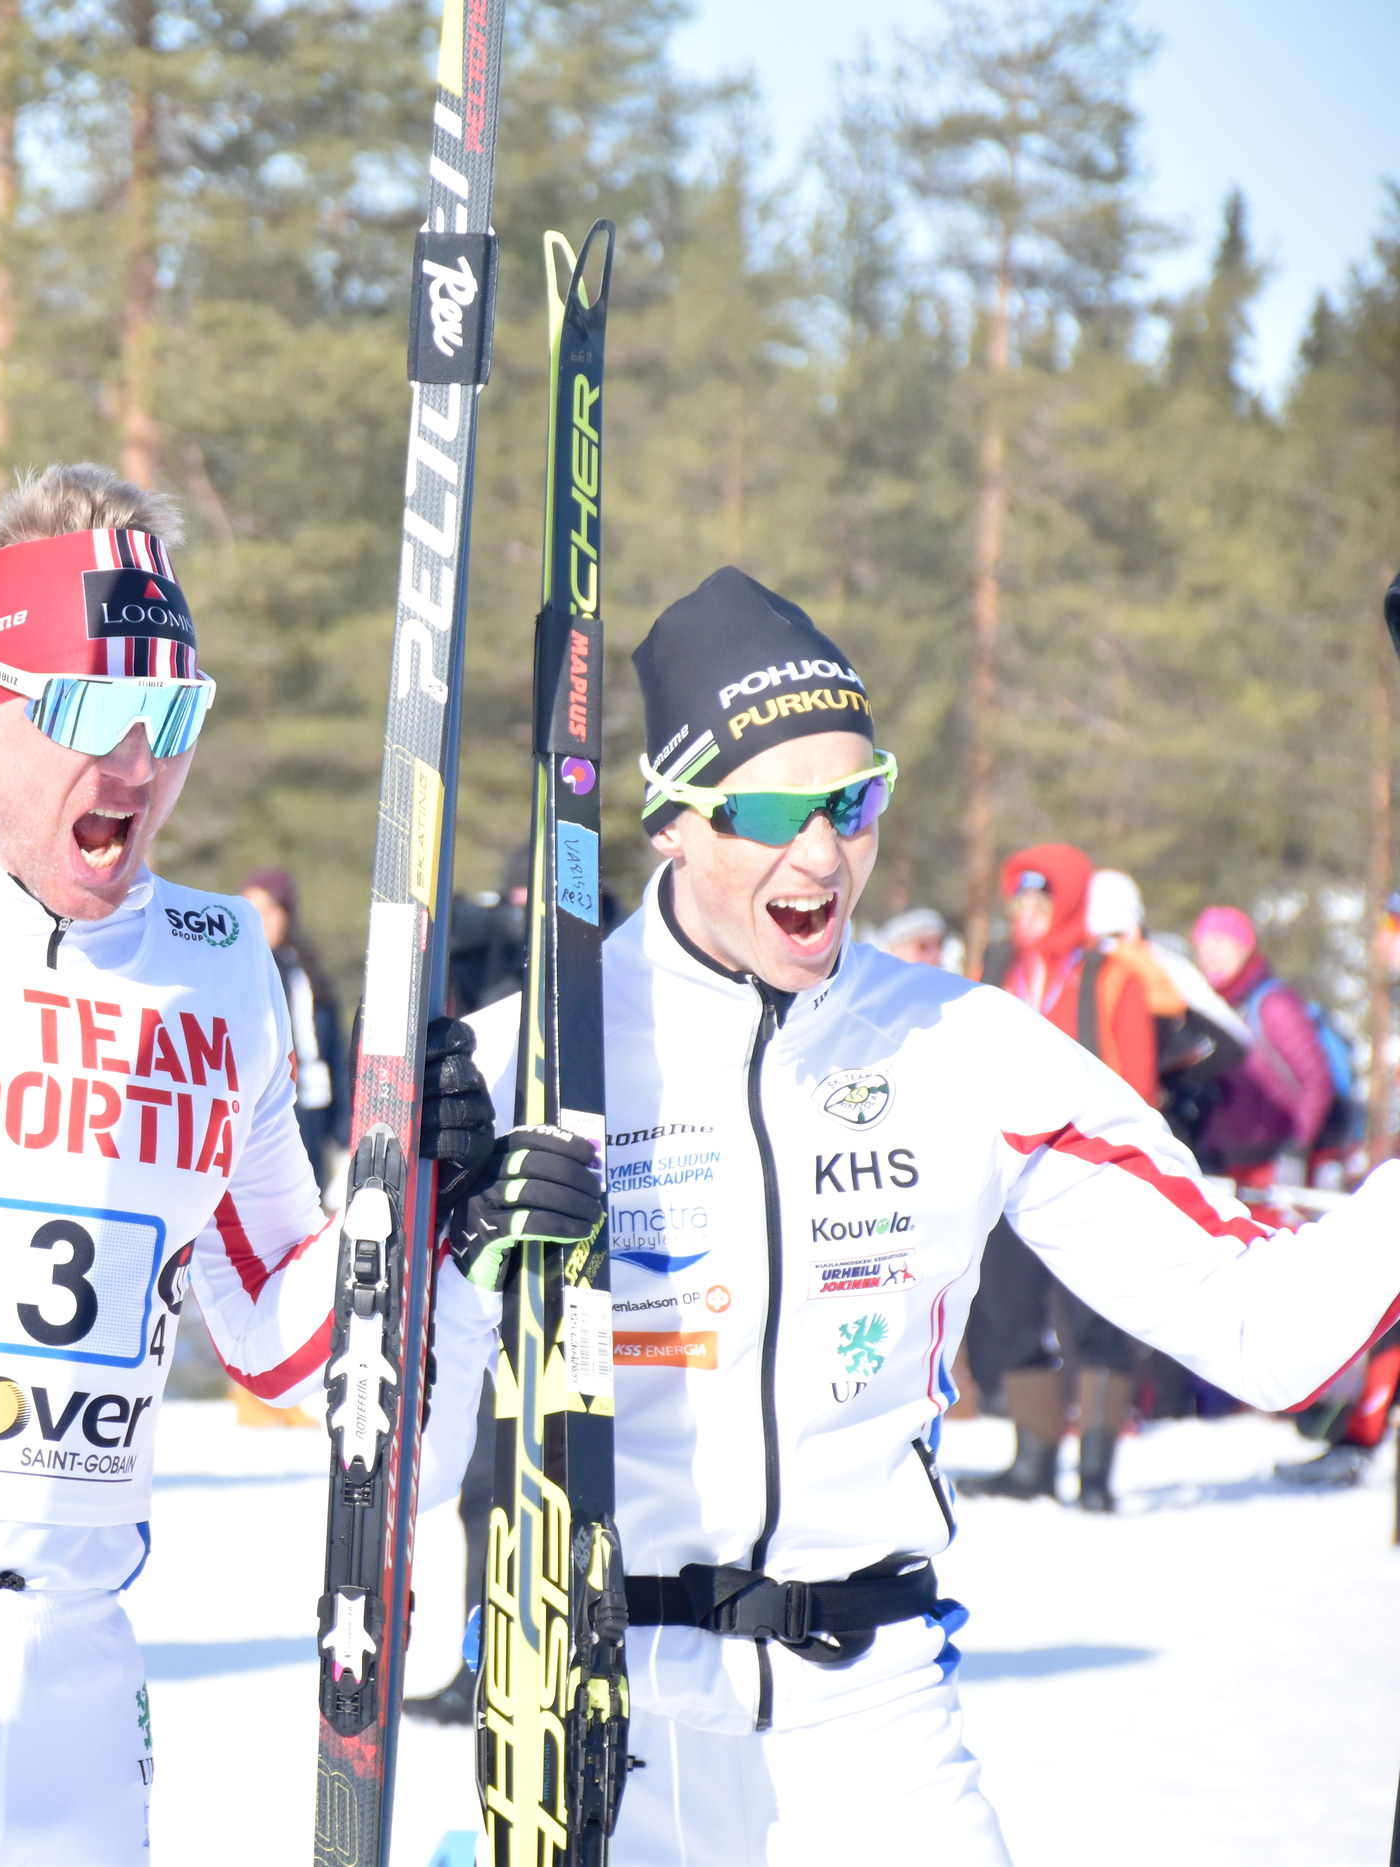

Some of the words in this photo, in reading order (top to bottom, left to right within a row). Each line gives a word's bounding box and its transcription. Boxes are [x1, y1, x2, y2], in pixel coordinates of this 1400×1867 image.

[421, 256, 478, 358] Rex
[568, 629, 590, 743] MAPLUS
[165, 908, 227, 937] SGN
[171, 929, 205, 943] GROUP
[23, 989, 240, 1092] TEAM
[658, 1151, 721, 1172] SEUDUN
[815, 1148, 920, 1195] KHS
[611, 1205, 708, 1234] Imatra
[811, 1211, 911, 1243] Kouvola
[17, 1219, 98, 1347] 3
[820, 1276, 881, 1293] JOKINEN
[822, 1263, 881, 1281] URHEILU
[683, 1291, 701, 1306] OP
[150, 1313, 167, 1367] 4
[614, 1342, 641, 1357] KSS
[646, 1342, 707, 1359] ENERGIA
[20, 1447, 138, 1474] SAINT-GOBAIN
